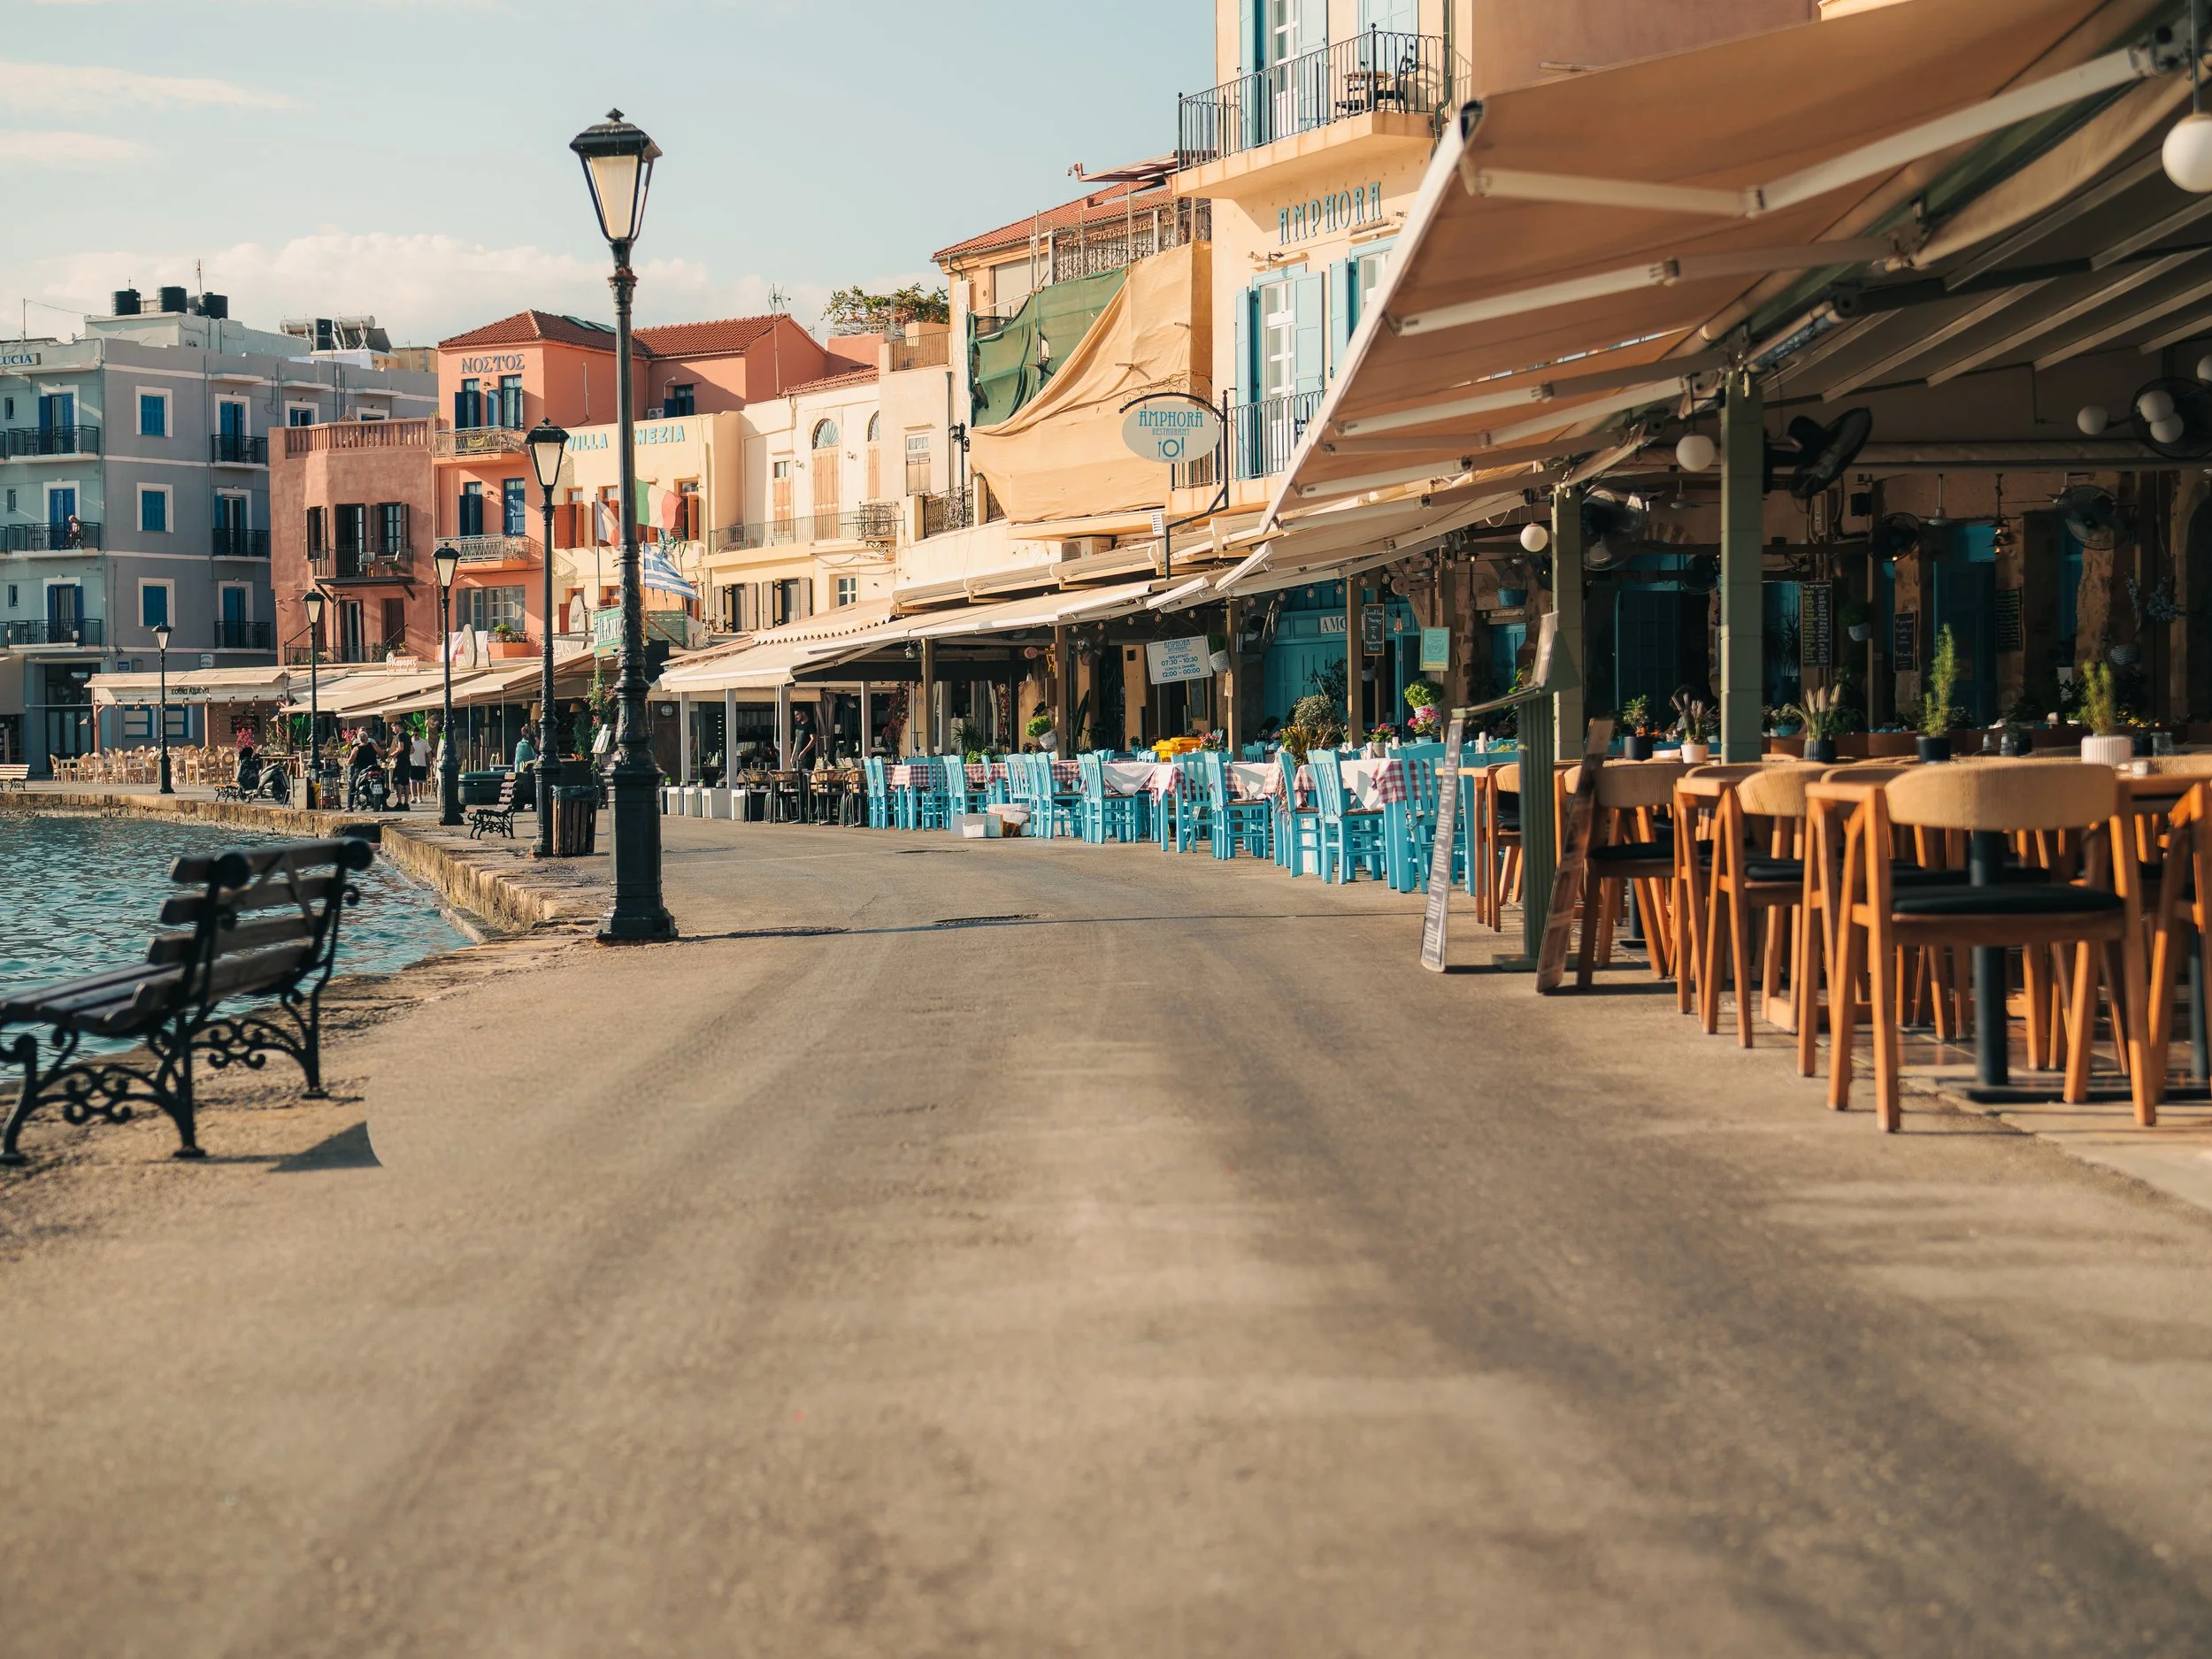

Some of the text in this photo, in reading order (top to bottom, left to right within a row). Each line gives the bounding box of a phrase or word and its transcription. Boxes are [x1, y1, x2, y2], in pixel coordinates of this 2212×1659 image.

[1278, 181, 1382, 245] AMPHORA
[461, 354, 525, 373] ΝΟΣΤΟΣ
[1139, 411, 1203, 427] AMPHORA
[568, 425, 686, 452] VILLA NEZIA
[1152, 427, 1190, 436] RESTAURANT
